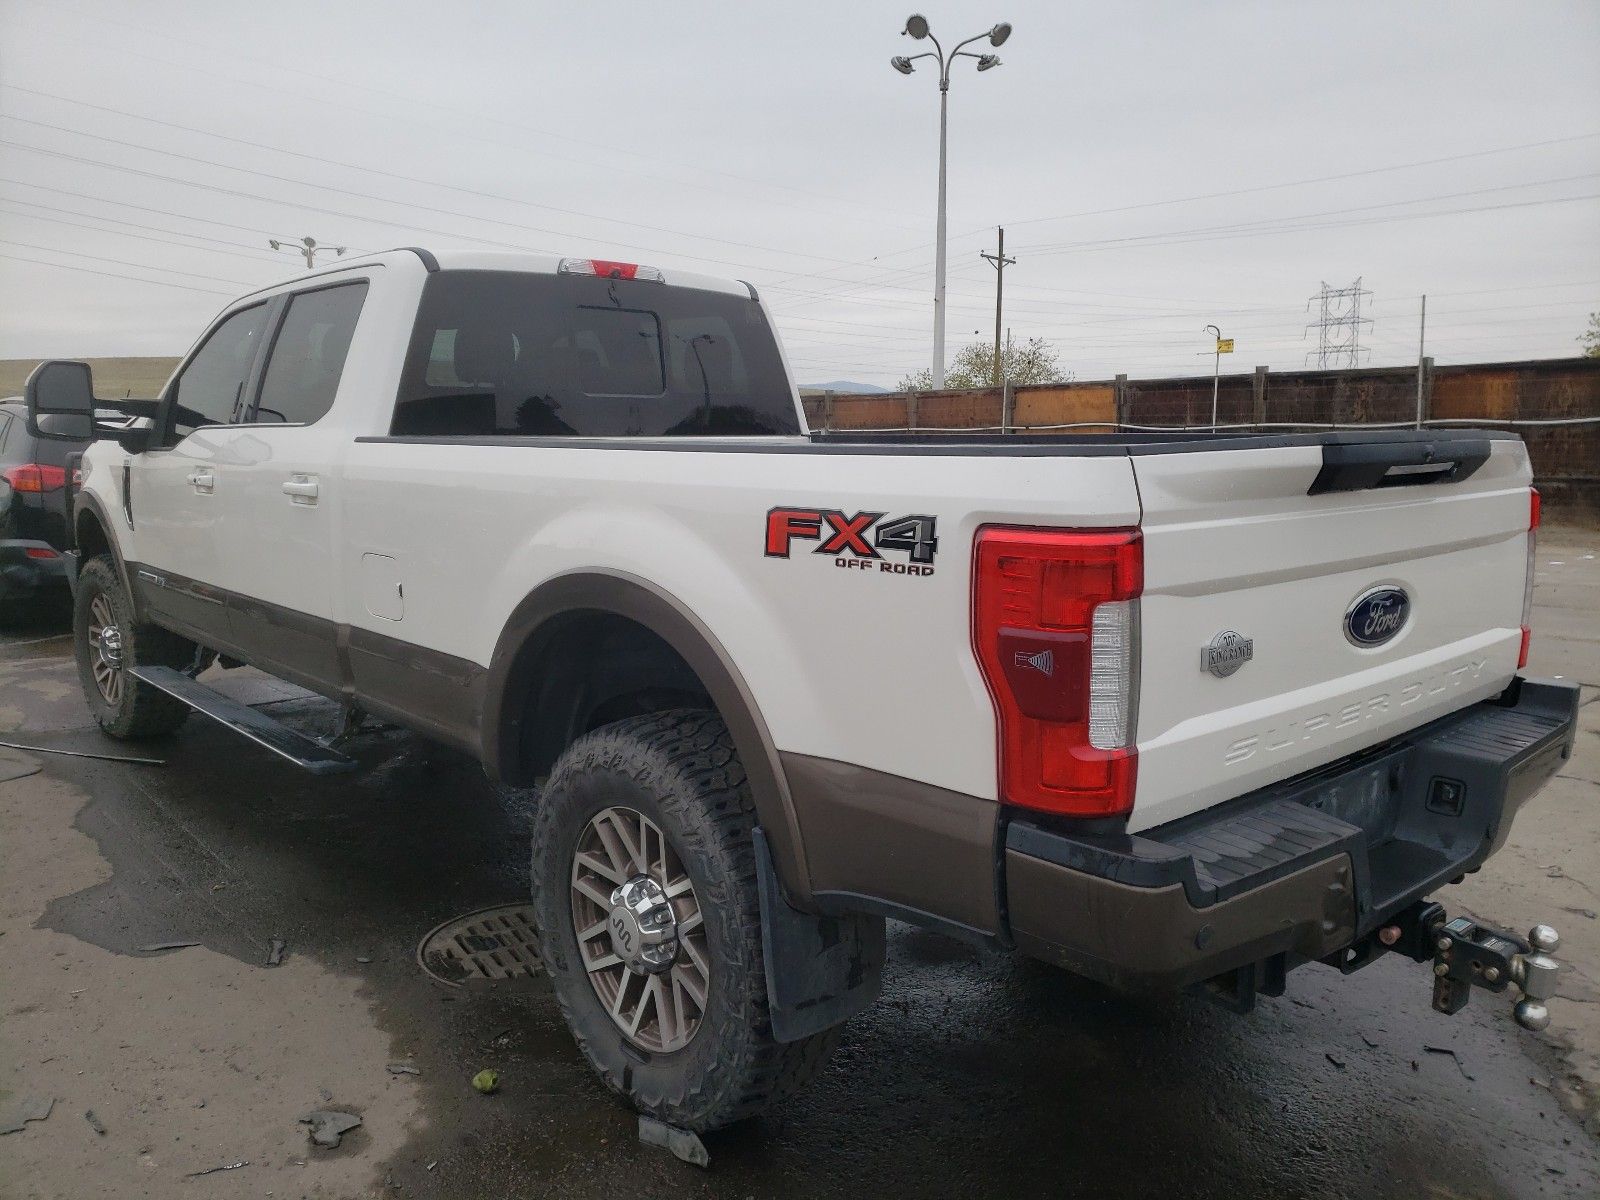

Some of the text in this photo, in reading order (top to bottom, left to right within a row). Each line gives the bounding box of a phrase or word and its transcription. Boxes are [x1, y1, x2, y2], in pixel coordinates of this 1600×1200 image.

[764, 506, 939, 565] FX4
[835, 557, 935, 577] OFF ROAD
[1364, 598, 1401, 635] Ford
[1224, 657, 1488, 766] SUPER DUTY
